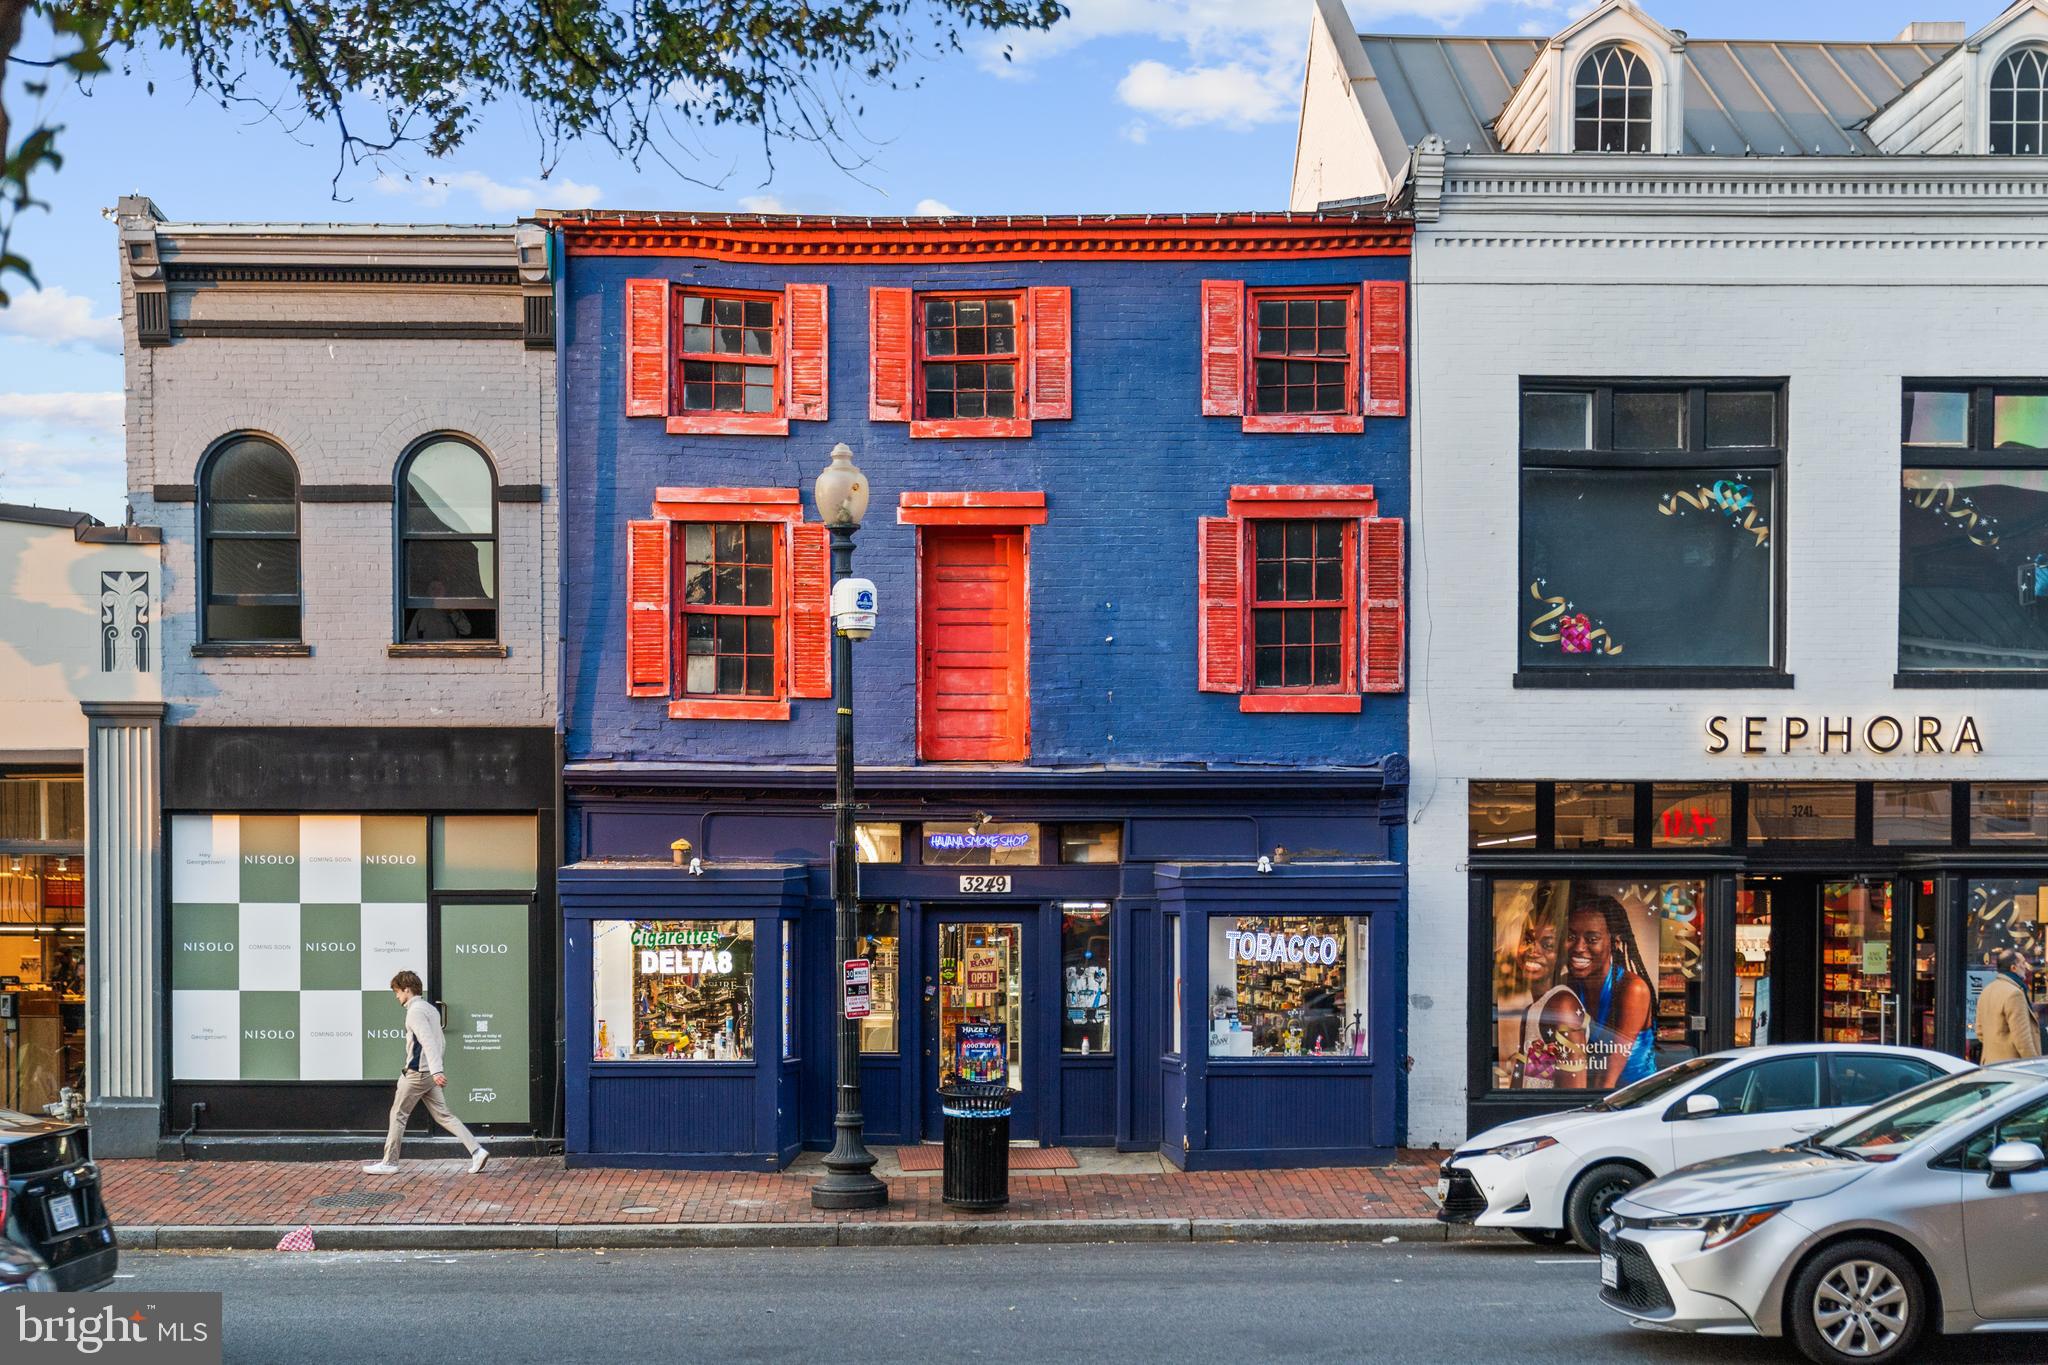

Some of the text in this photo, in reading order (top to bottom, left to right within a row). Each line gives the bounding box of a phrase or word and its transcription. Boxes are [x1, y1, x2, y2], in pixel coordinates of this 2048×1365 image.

[1704, 715, 1984, 753] SEPHORA
[1792, 805, 1813, 817] 3241
[930, 834, 1029, 848] HAVANA SMOKE SHOP
[244, 855, 295, 865] NISOLO
[366, 855, 416, 865] NISOLO
[962, 876, 1007, 892] 3249
[631, 928, 719, 949] Cigarettes
[183, 942, 234, 952] NISOLO
[305, 942, 356, 952] NISOLO
[455, 944, 508, 954] NISOLO
[1225, 931, 1338, 965] TOBACCO
[970, 958, 994, 967] RAW
[846, 970, 854, 979] 30
[971, 972, 993, 983] OPEN
[244, 1030, 295, 1040] NISOLO
[367, 1029, 407, 1039] NISOL
[1554, 1056, 1607, 1070] eautful
[469, 1092, 496, 1103] LEAP
